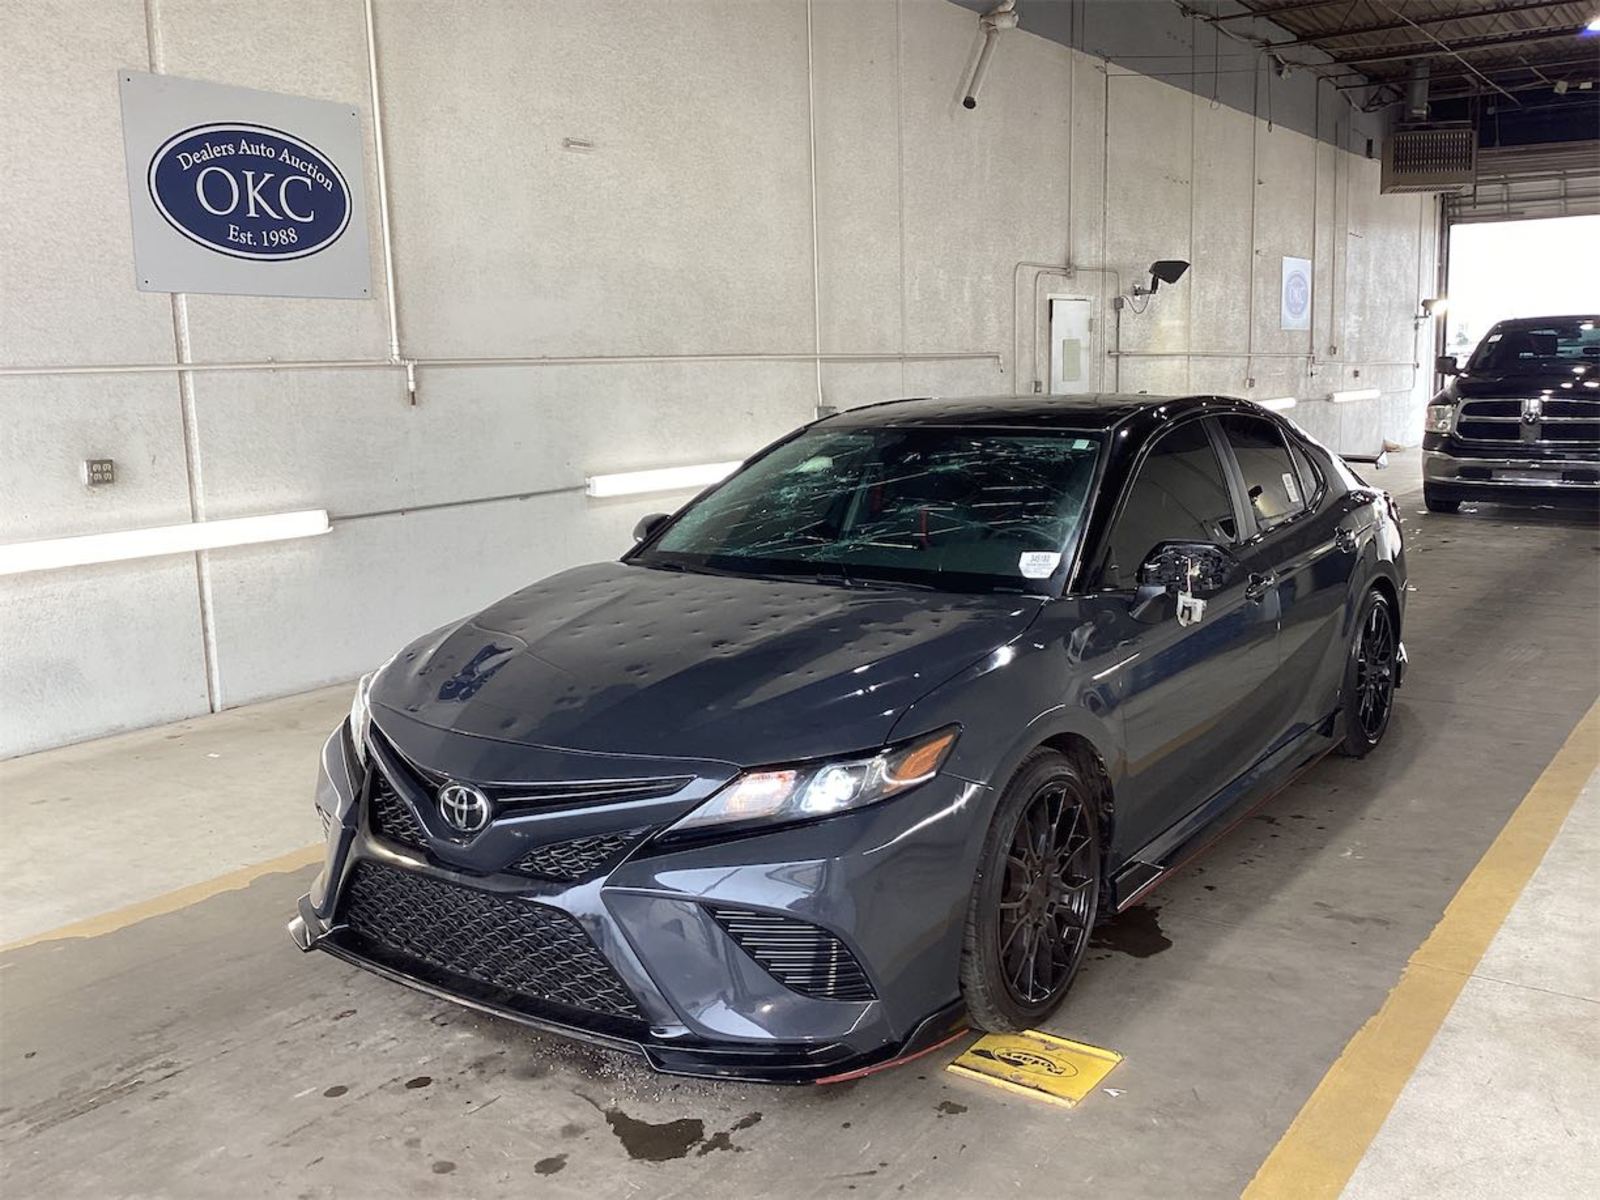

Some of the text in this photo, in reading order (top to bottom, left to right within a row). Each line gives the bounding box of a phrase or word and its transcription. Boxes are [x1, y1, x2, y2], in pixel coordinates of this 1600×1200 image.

[176, 139, 334, 192] Dealers Auto Auction
[196, 166, 315, 223] OKC
[227, 224, 299, 247] Est. 1988
